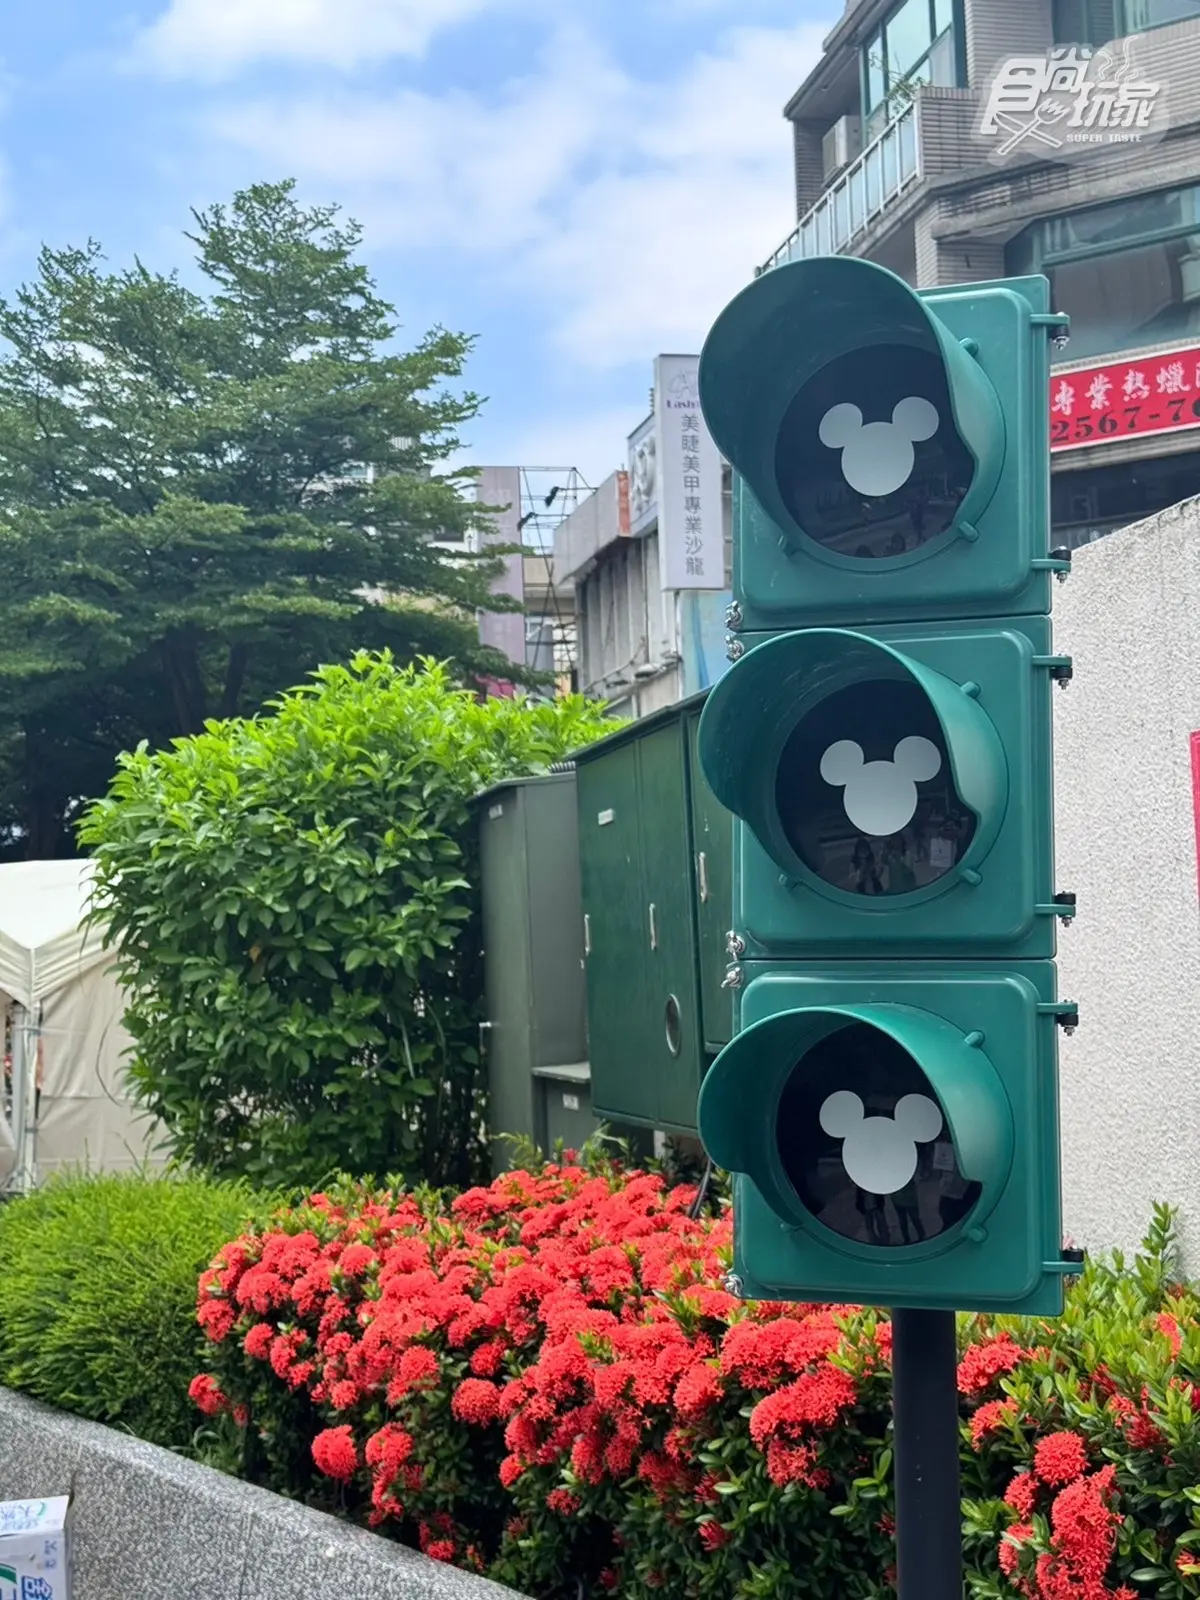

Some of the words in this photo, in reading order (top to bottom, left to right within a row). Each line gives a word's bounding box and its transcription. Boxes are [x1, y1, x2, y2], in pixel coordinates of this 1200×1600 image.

[1051, 360, 1200, 416] 專業熱蠟
[681, 413, 705, 576] 美睫美甲專業沙龍
